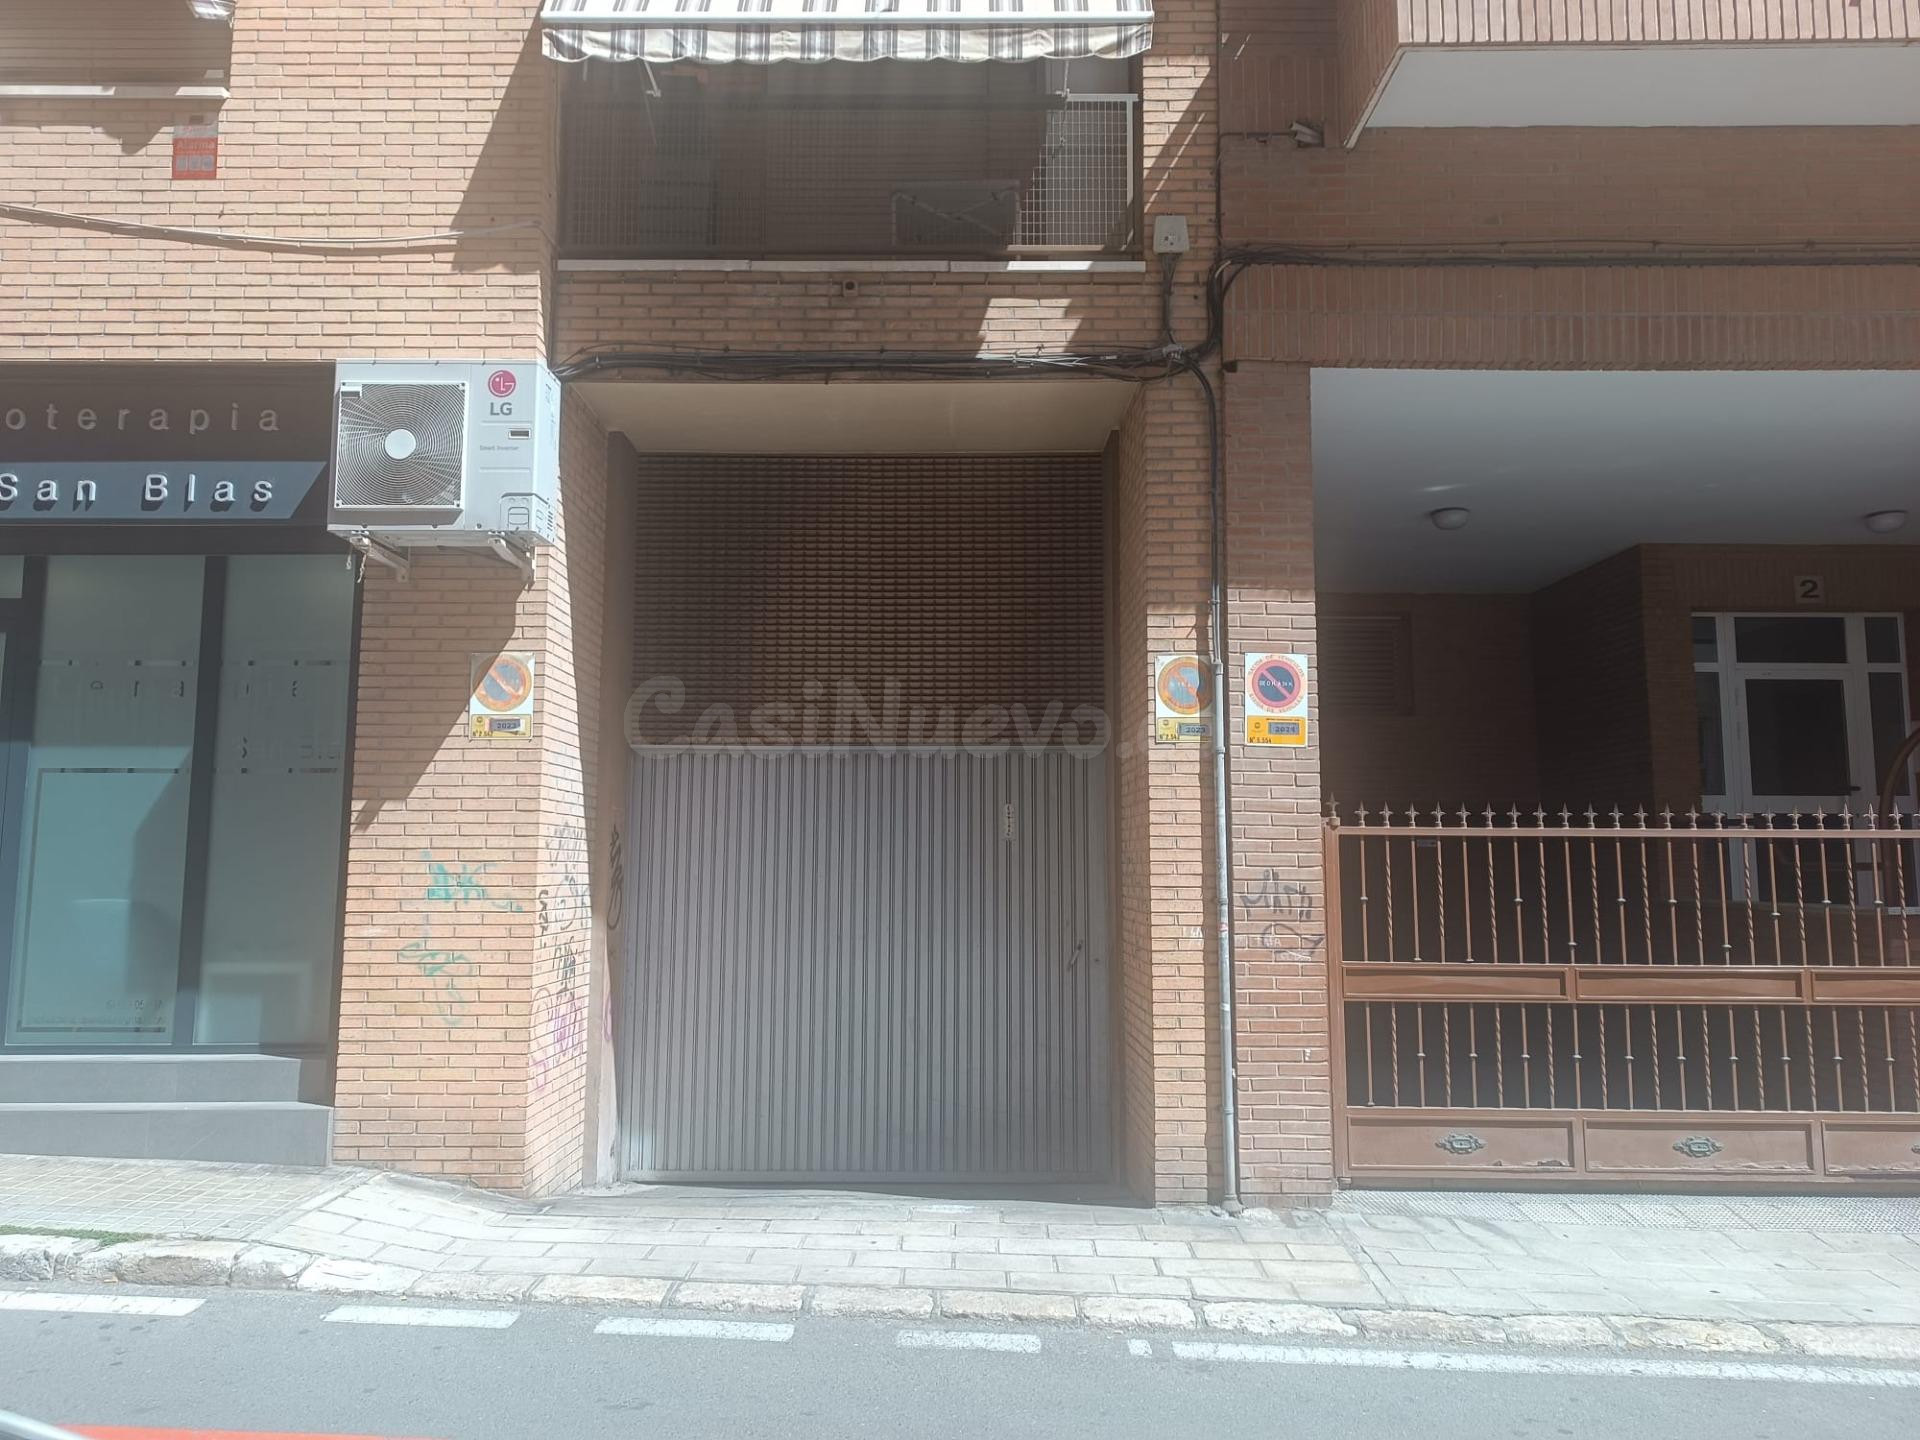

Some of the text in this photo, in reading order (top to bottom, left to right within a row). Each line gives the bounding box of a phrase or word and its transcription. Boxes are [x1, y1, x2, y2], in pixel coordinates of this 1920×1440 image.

[489, 402, 513, 416] LG
[0, 472, 273, 502] San Blas
[1800, 580, 1820, 598] 2
